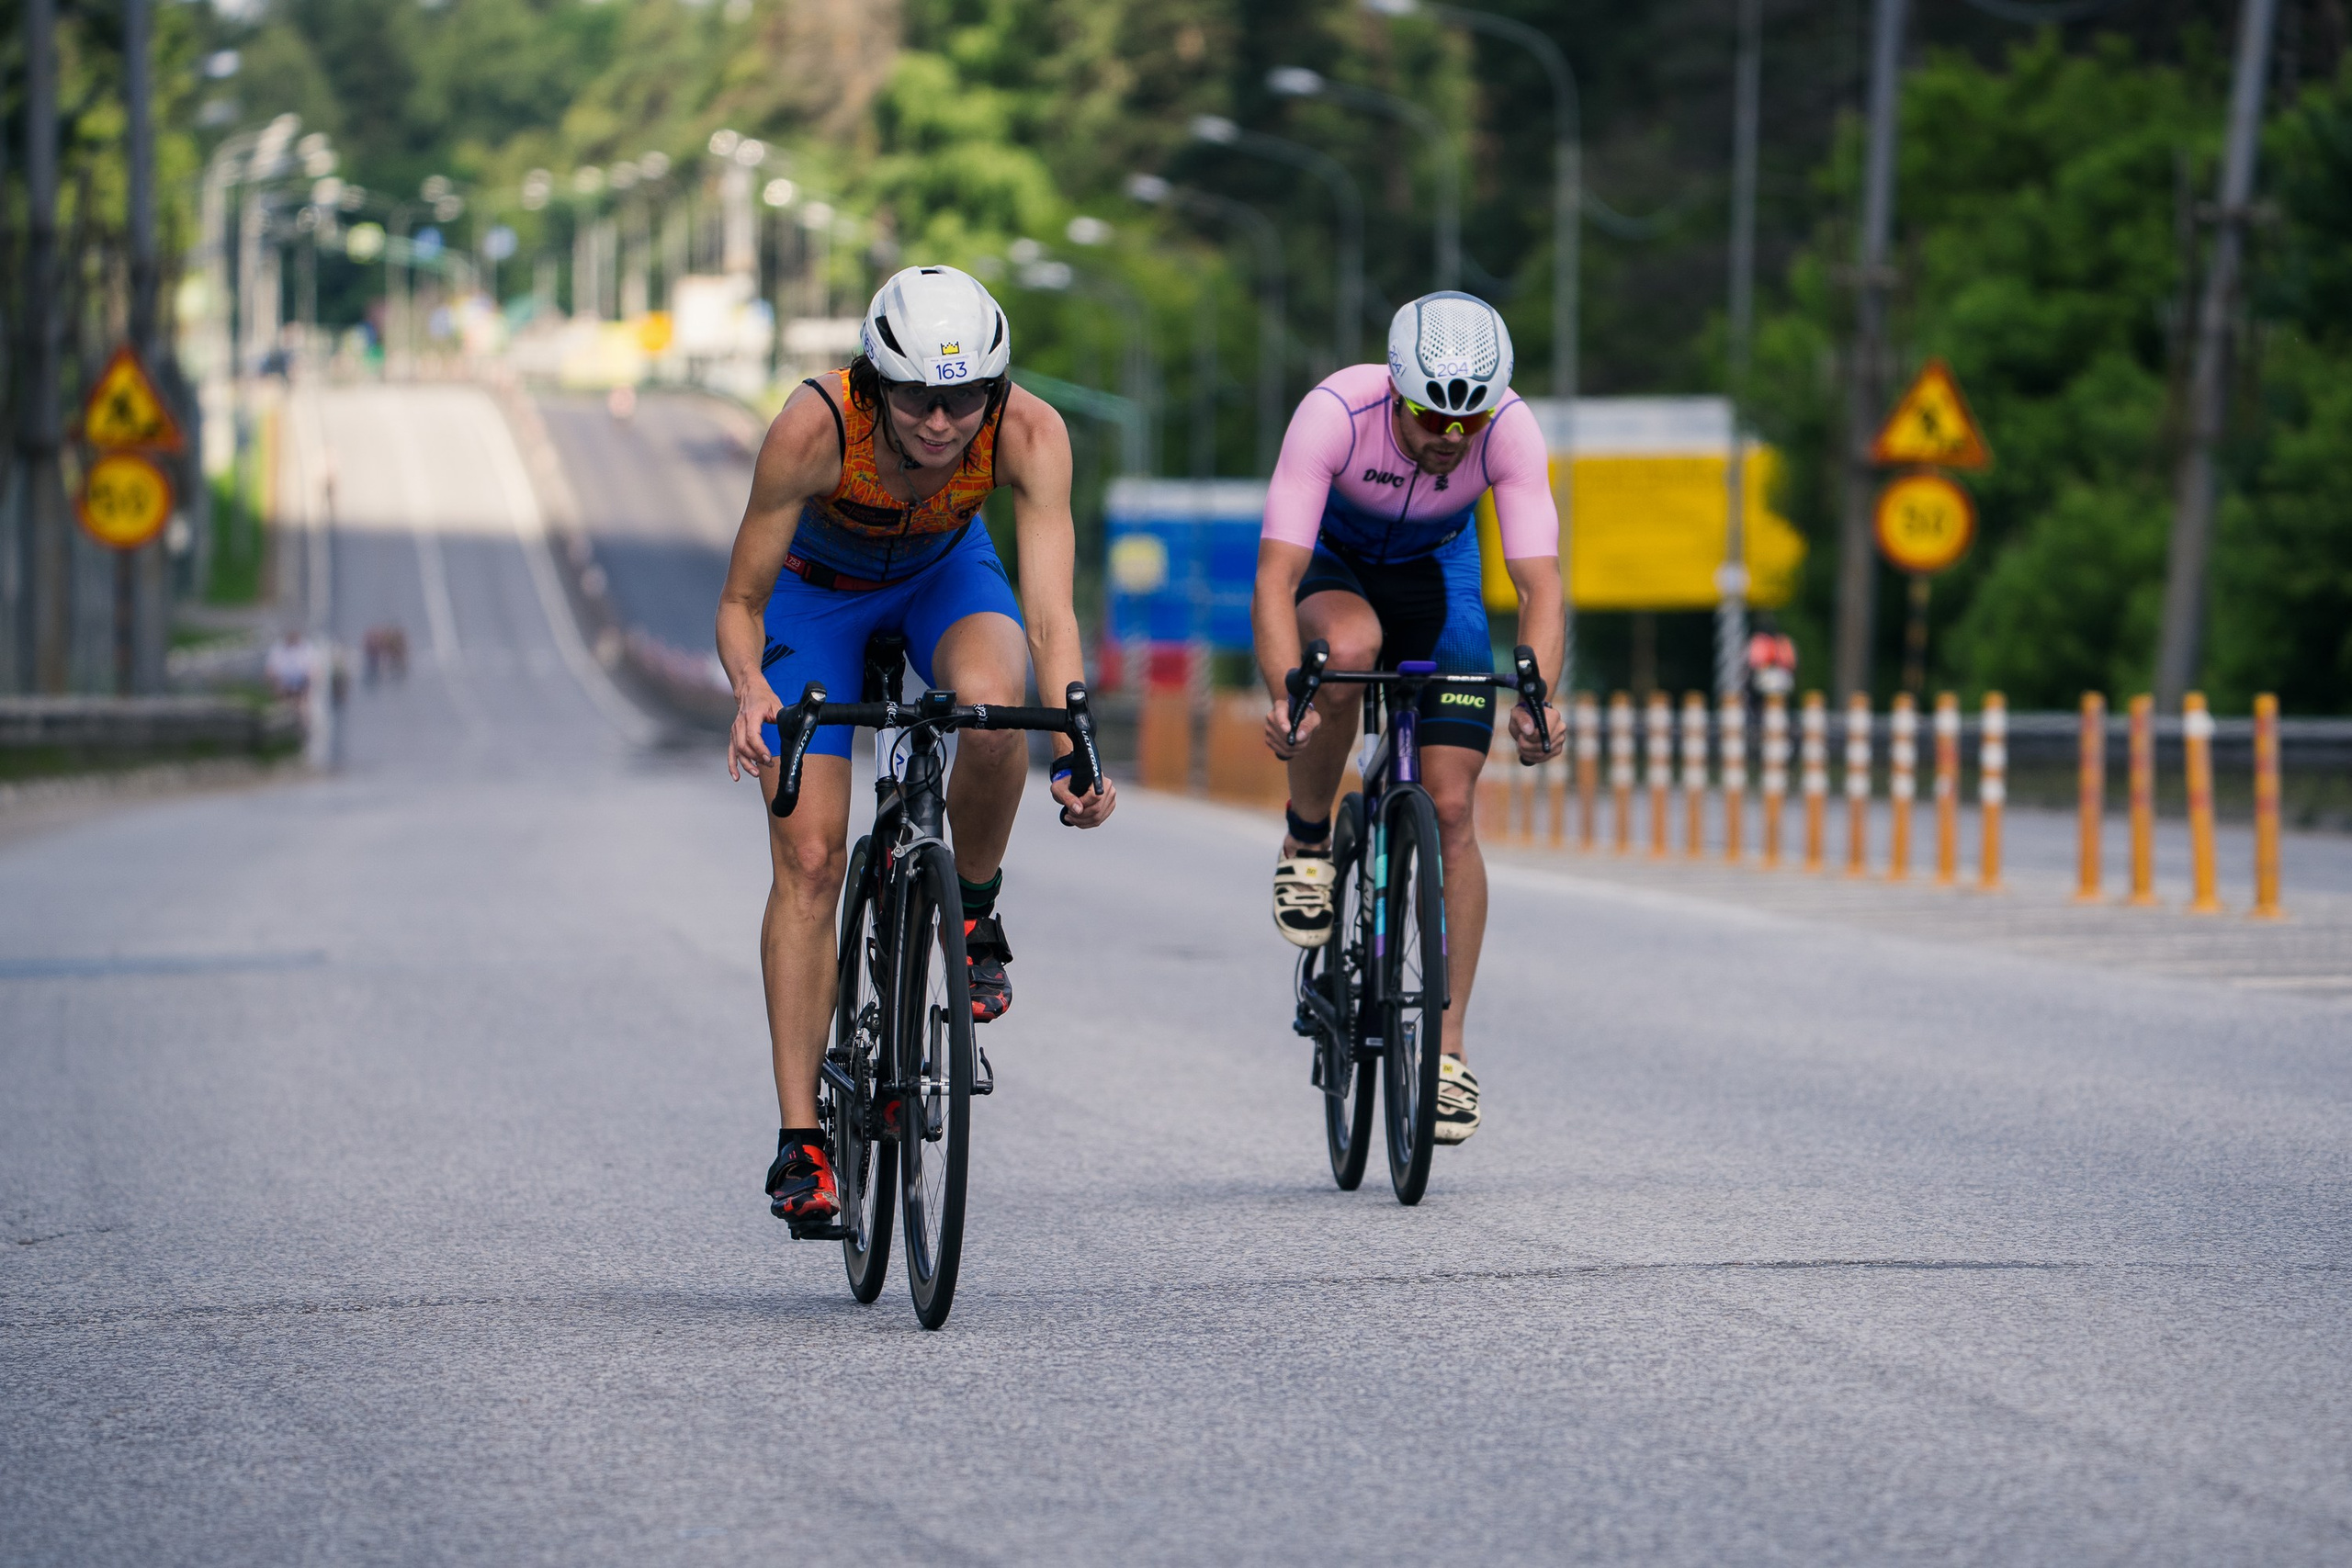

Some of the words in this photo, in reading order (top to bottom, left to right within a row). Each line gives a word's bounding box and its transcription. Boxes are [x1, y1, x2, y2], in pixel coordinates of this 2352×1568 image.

[935, 361, 967, 380] 163
[1437, 362, 1468, 378] 204
[1363, 468, 1405, 488] DWC
[1441, 693, 1486, 707] DWC
[790, 729, 810, 776] ULTEGRA
[1081, 730, 1100, 777] ULTEGRA
